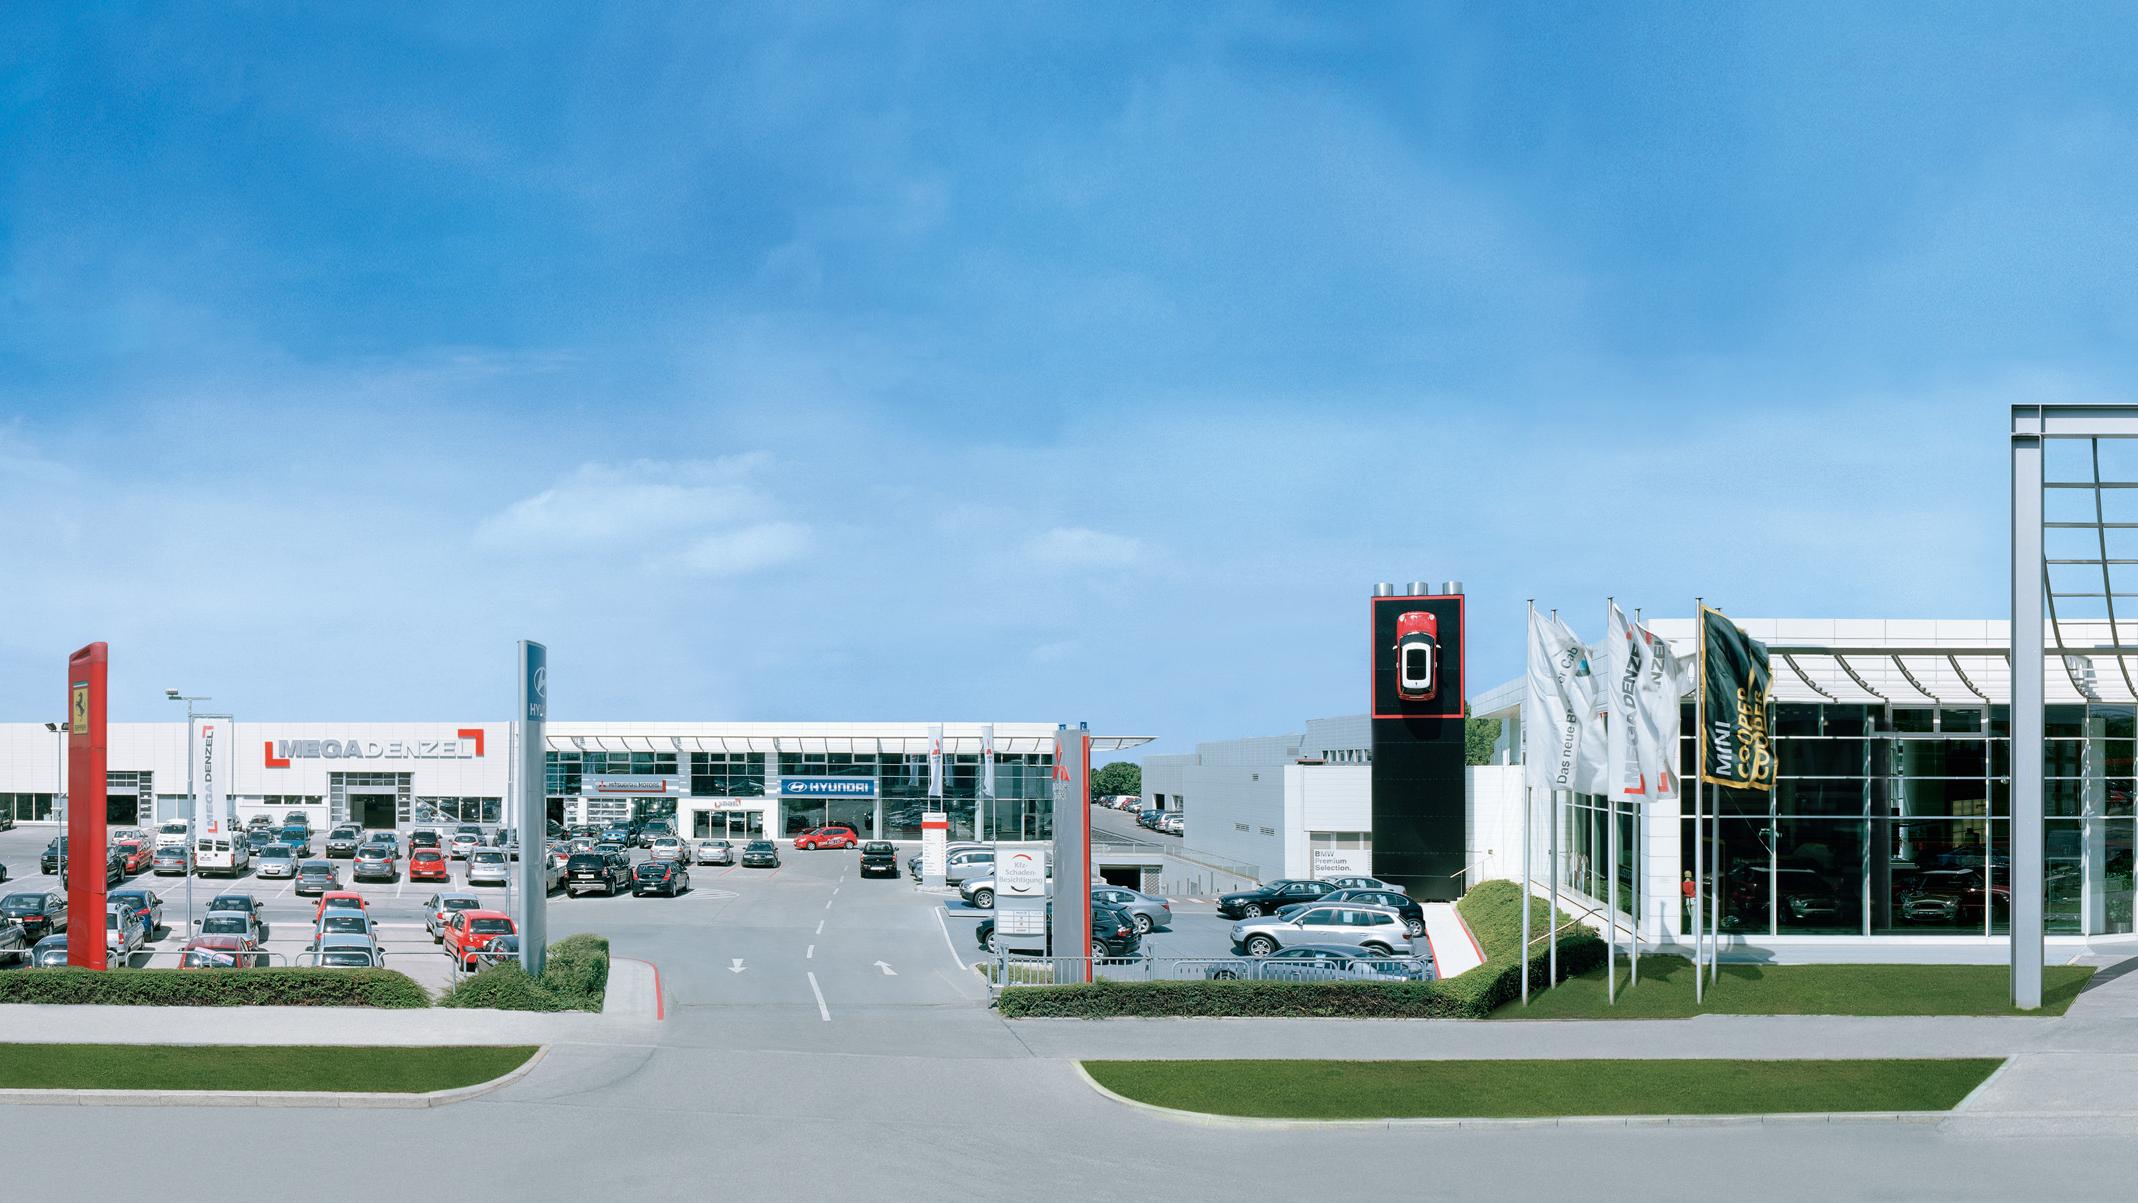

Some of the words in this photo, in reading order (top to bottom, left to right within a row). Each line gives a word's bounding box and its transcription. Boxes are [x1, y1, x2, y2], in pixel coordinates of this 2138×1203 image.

[1715, 720, 1732, 776] MINI
[1556, 760, 1570, 784] Das
[1563, 726, 1576, 757] neue
[809, 782, 869, 793] HYUNDAI
[1314, 857, 1348, 865] Premium
[1314, 864, 1352, 872] Selection.
